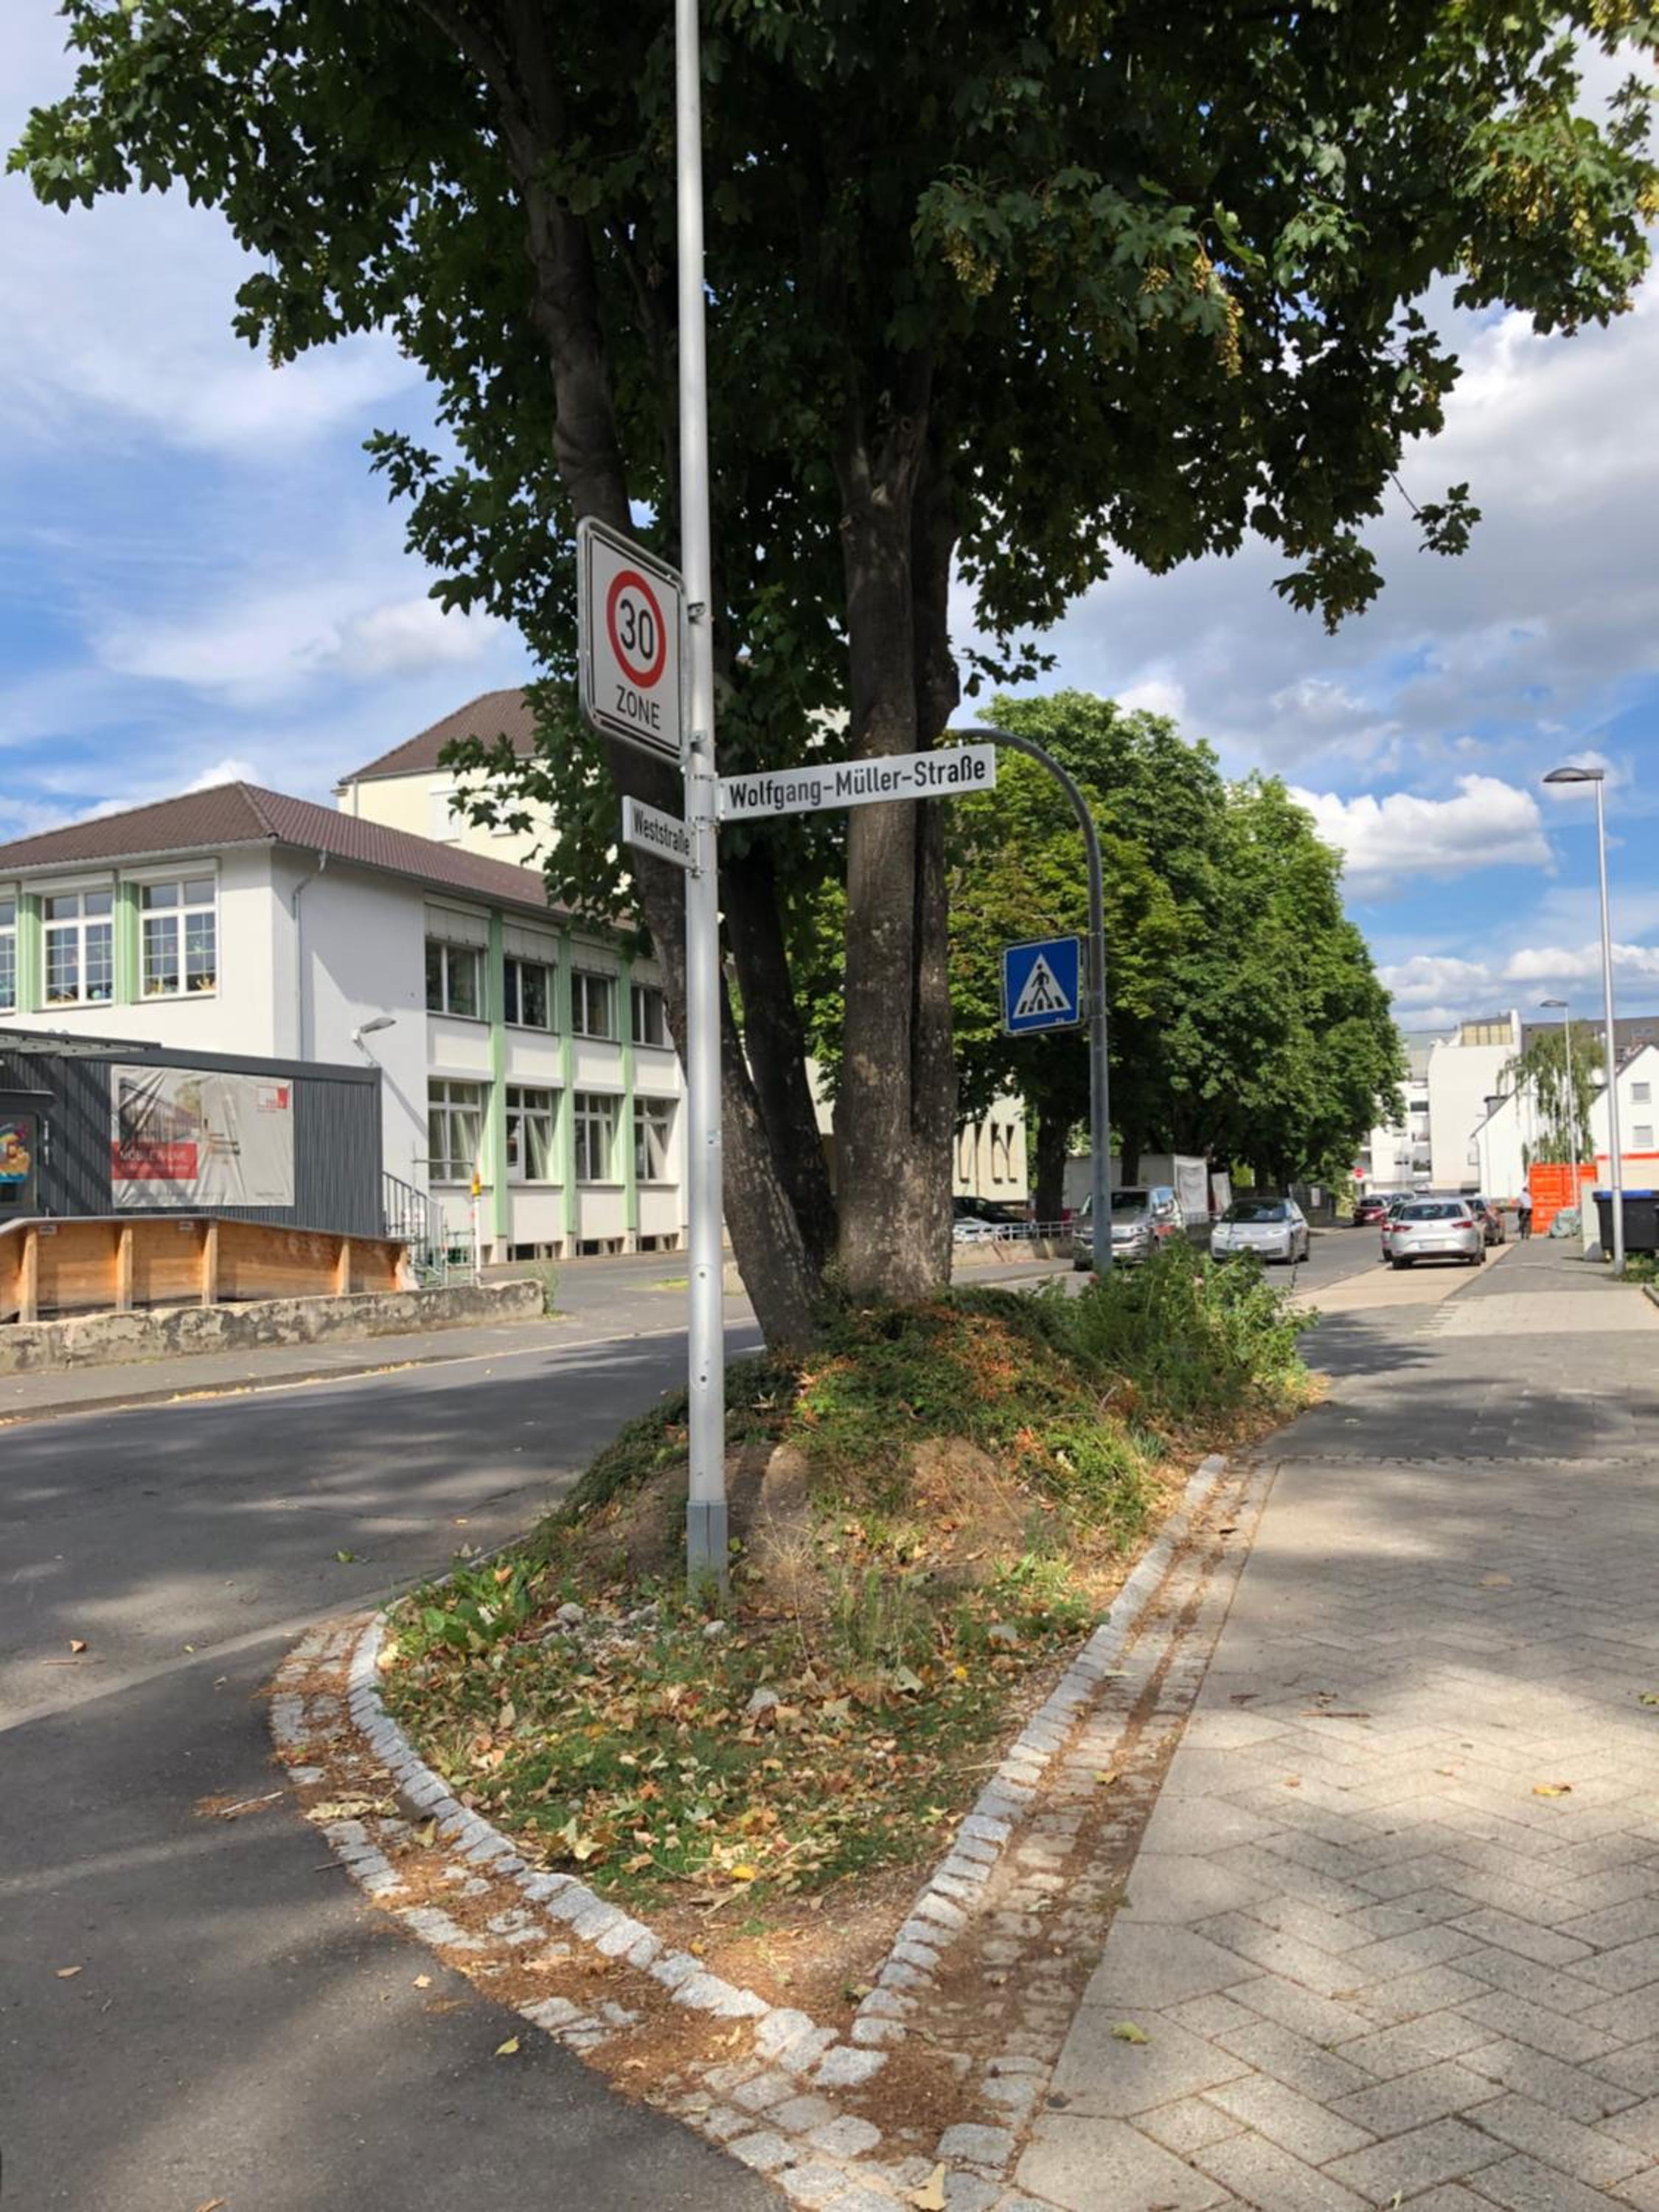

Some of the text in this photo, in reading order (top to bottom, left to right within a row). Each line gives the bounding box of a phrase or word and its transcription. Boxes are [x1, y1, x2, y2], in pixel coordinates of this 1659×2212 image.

[620, 599, 653, 660] 30
[616, 684, 661, 730] ZONE
[729, 754, 986, 810] Wolfgang-Müller-Straße
[635, 808, 691, 857] Weststraße
